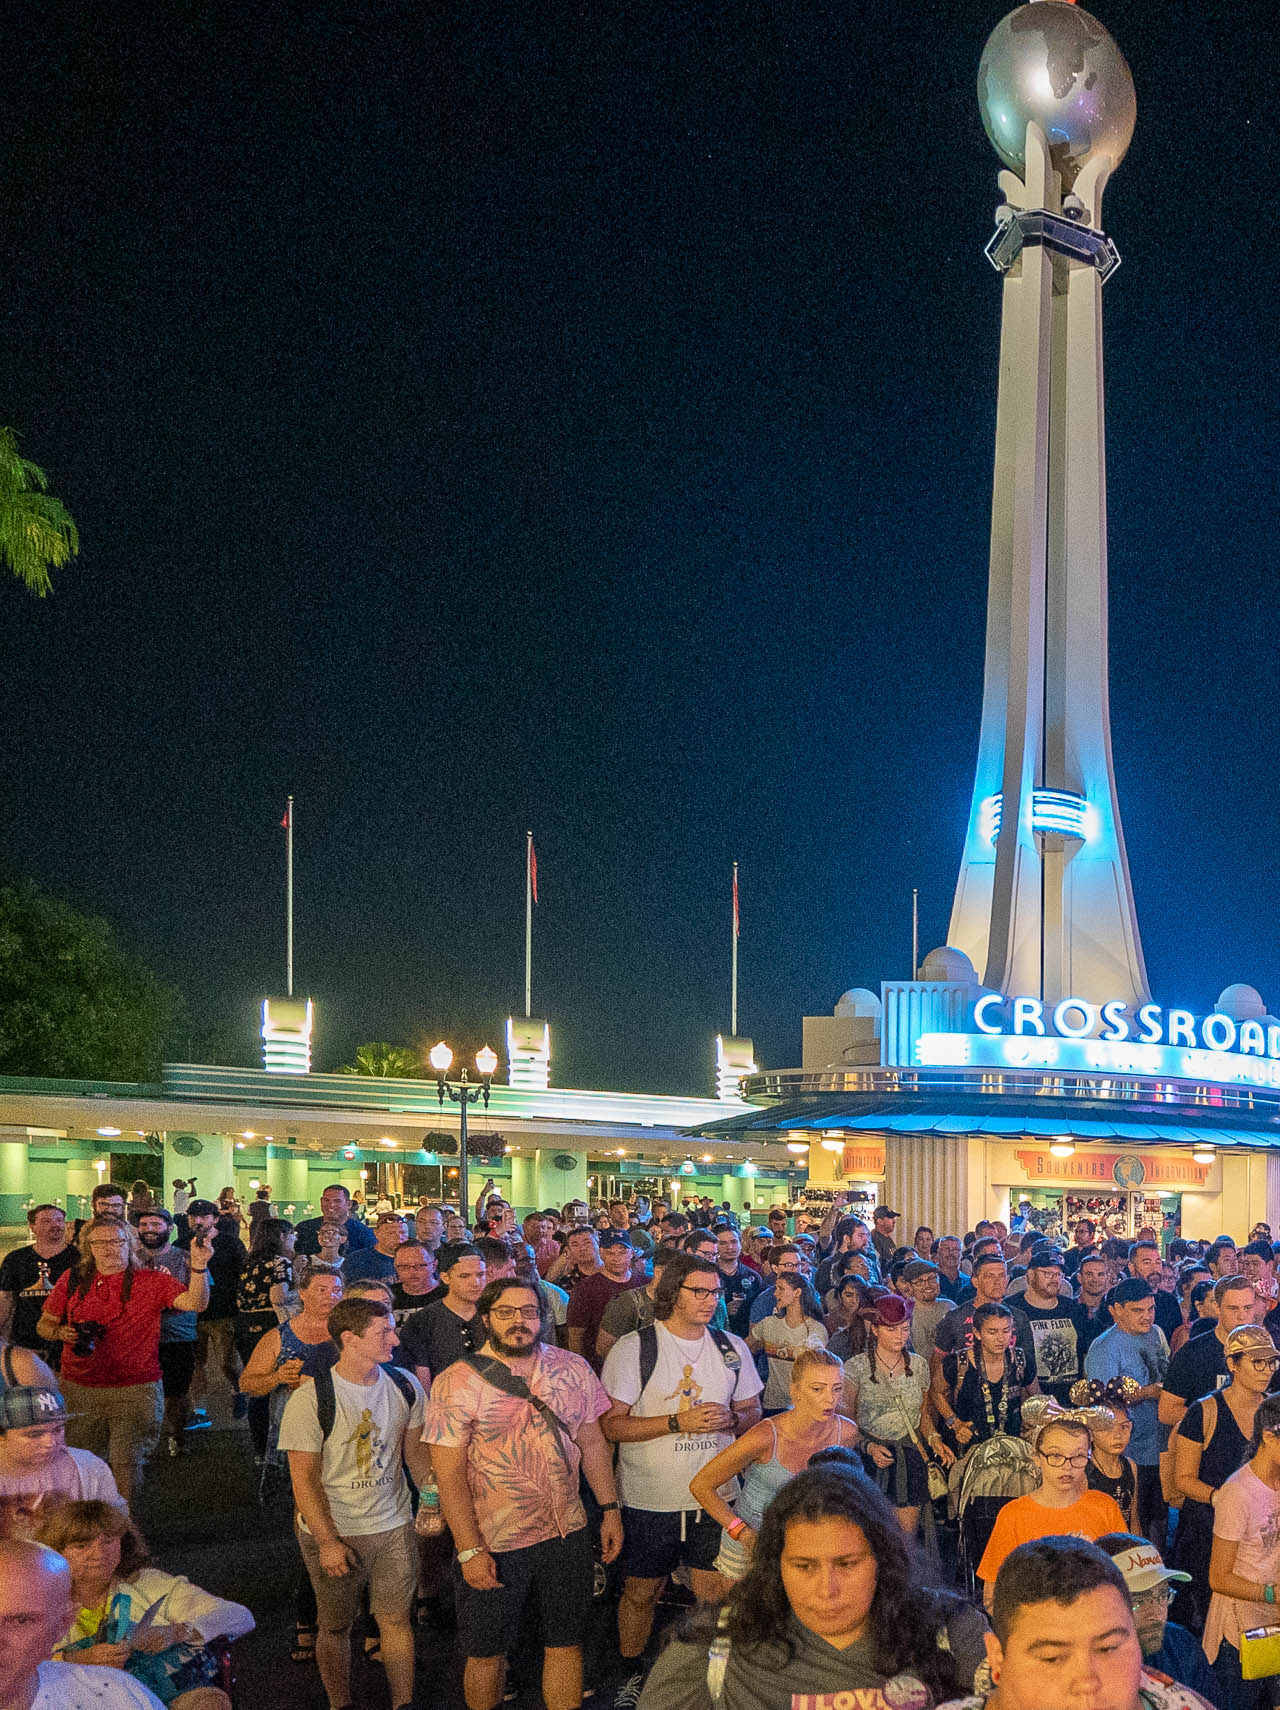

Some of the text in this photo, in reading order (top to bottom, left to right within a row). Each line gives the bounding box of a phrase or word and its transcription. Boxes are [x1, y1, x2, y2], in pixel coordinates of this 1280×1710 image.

[1037, 1156, 1105, 1176] SOUVENIRS
[1032, 1318, 1073, 1331] PINK FLOYD
[38, 1393, 60, 1411] NY
[674, 1439, 721, 1452] DROIDS
[351, 1475, 394, 1490] DROIDS
